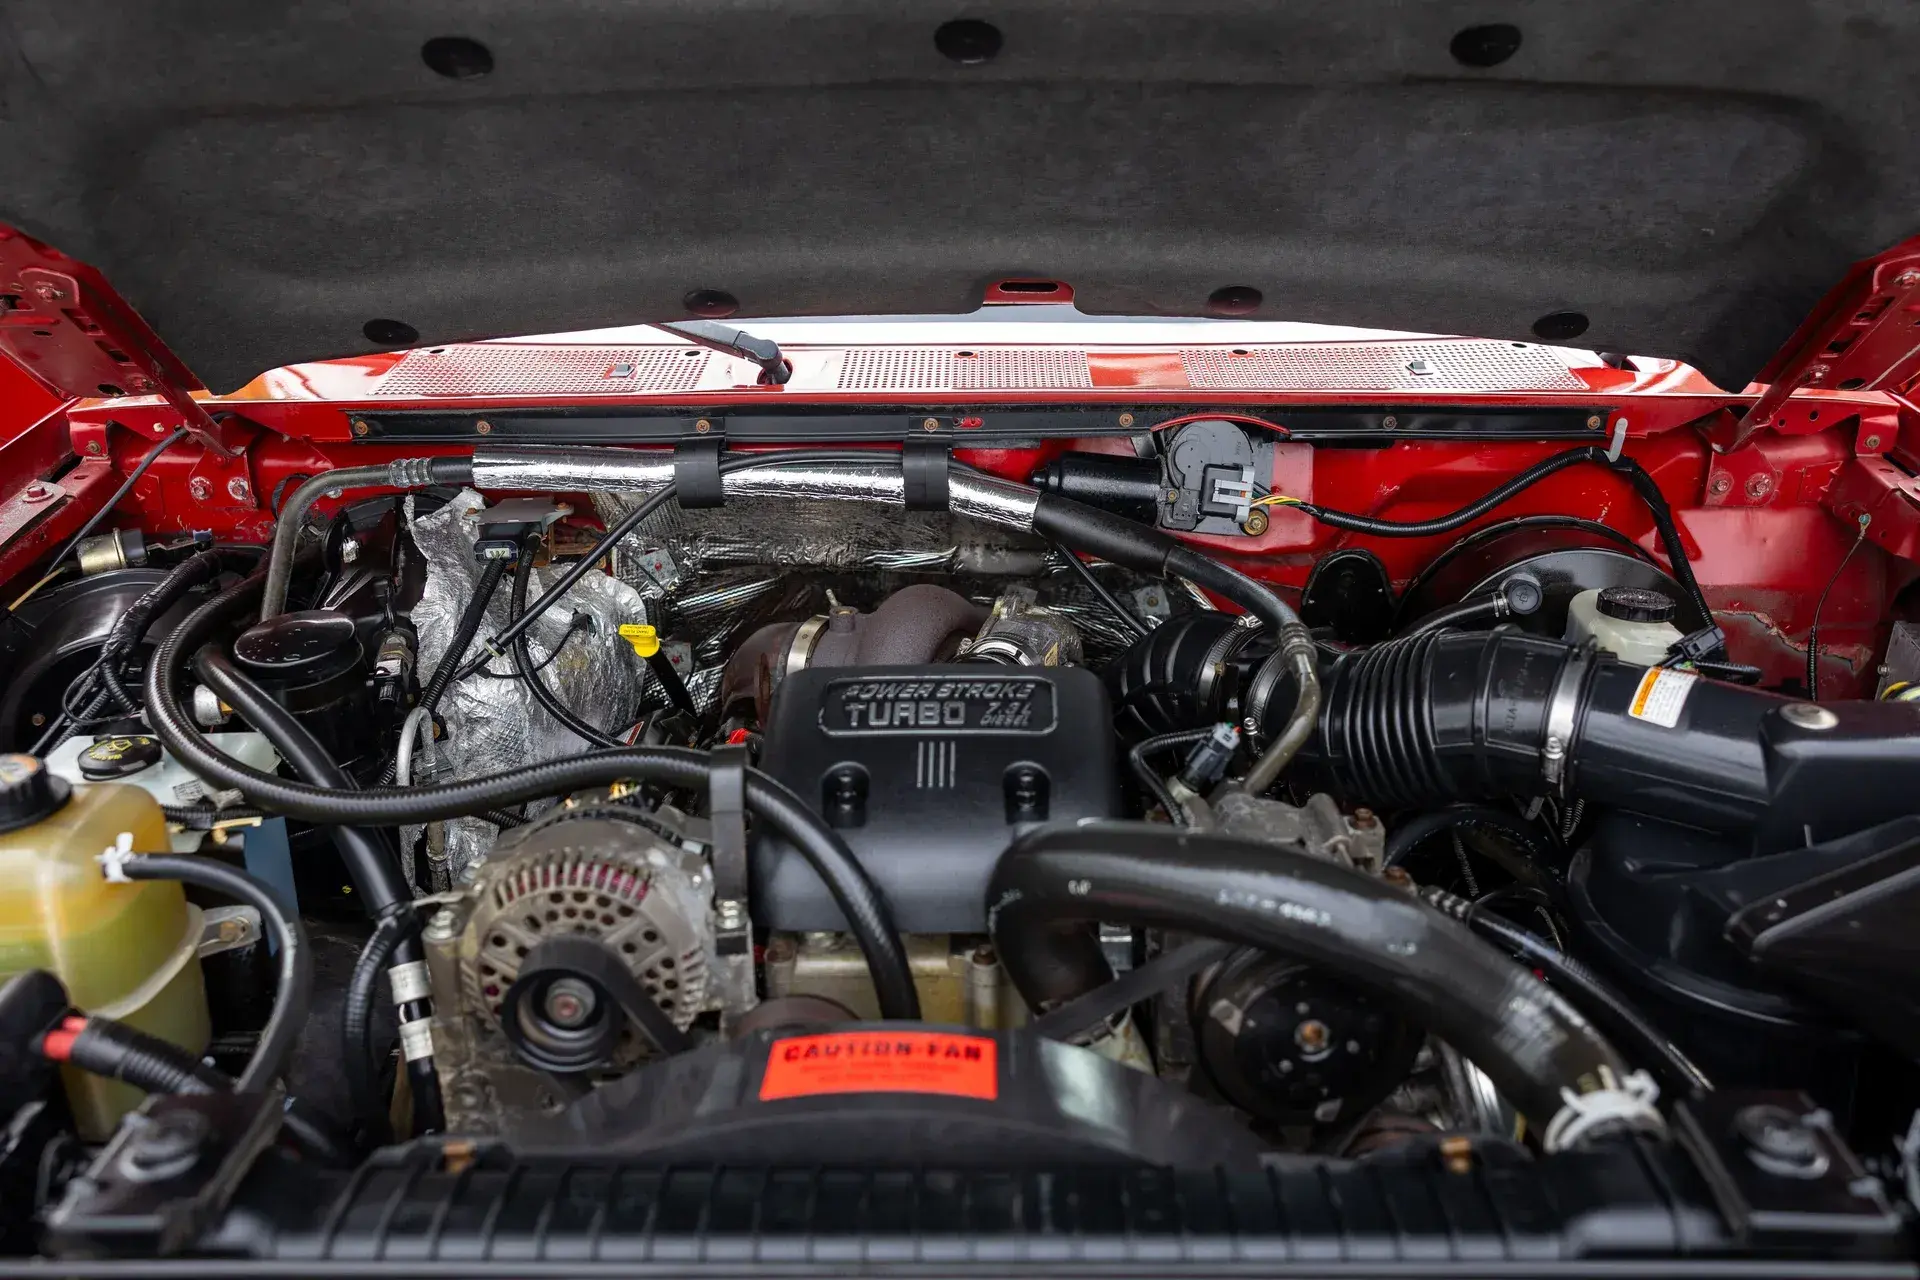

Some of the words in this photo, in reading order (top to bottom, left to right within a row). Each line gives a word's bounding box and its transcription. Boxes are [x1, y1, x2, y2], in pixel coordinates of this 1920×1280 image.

[841, 682, 935, 699] POWER
[936, 682, 1036, 698] STROKE
[845, 701, 966, 726] TURBO
[979, 714, 1031, 726] DIESEL
